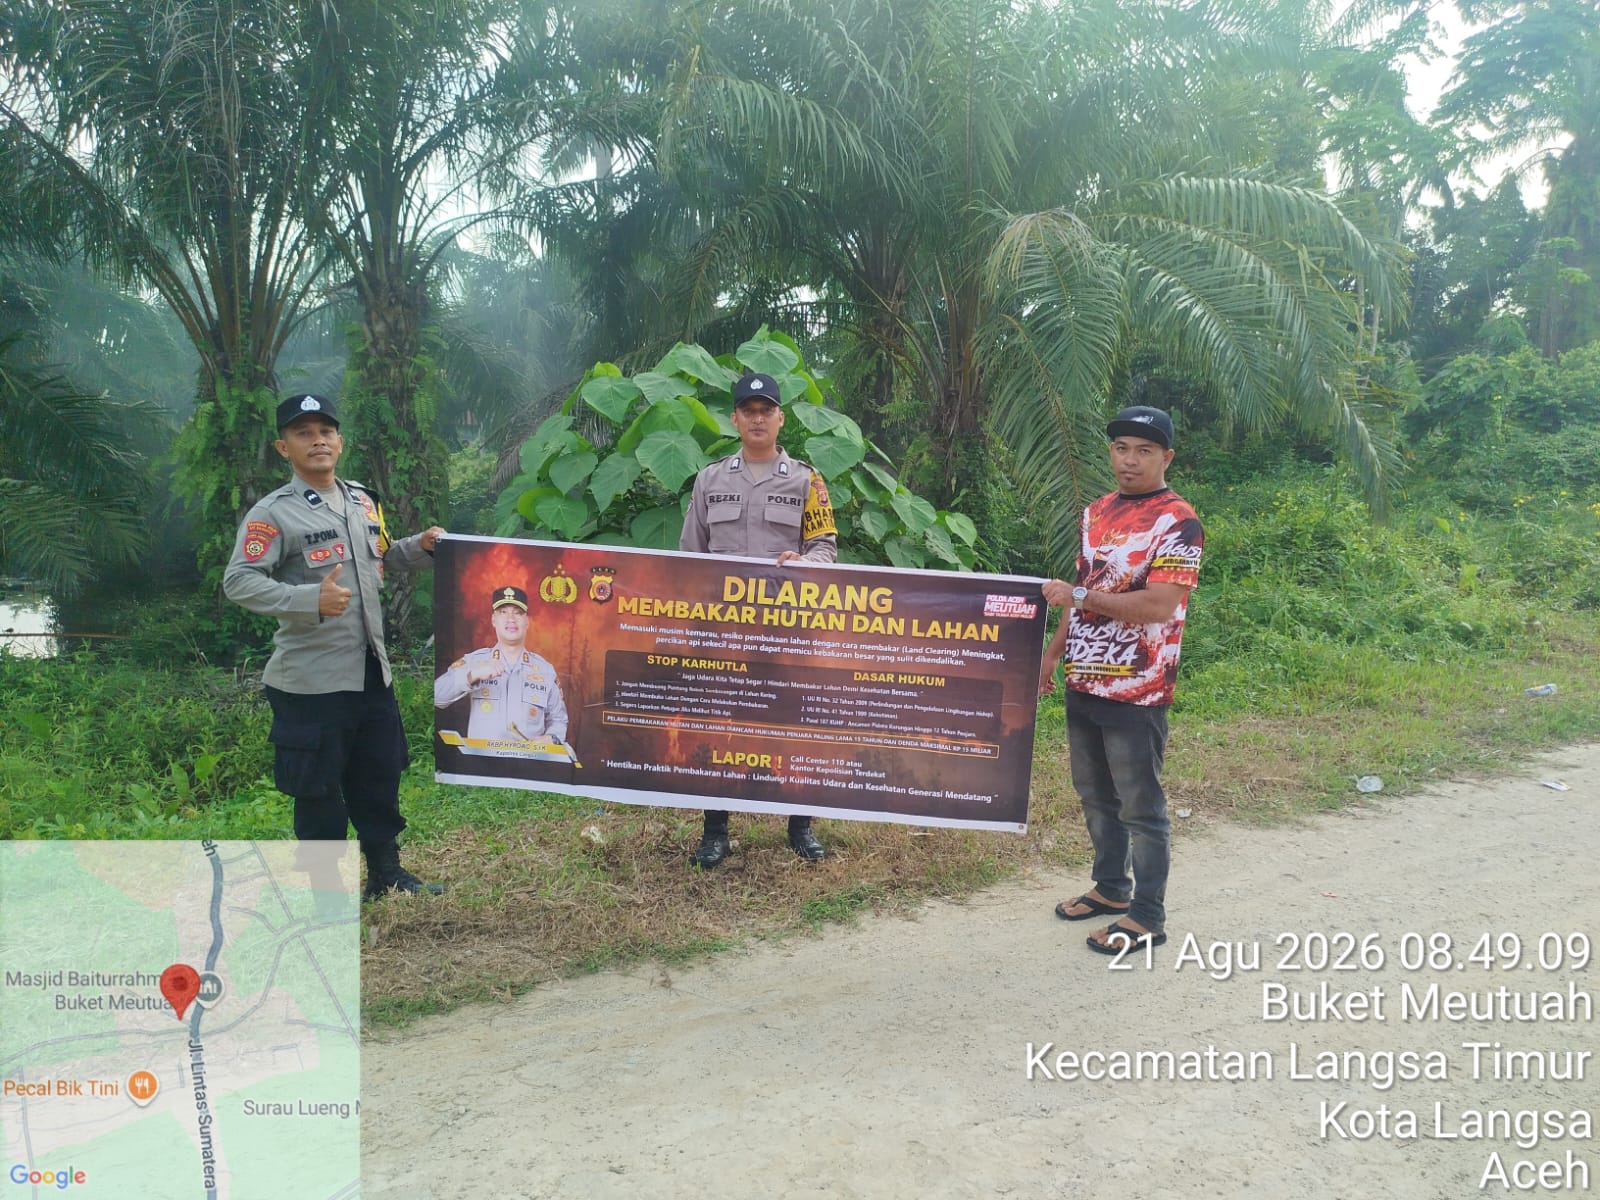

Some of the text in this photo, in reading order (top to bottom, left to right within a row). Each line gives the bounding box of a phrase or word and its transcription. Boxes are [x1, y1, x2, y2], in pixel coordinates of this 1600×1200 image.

[708, 494, 741, 504] REZKI
[767, 495, 802, 506] POLRI
[722, 574, 892, 614] DILARANG
[984, 600, 1036, 615] MEUTUAH
[617, 595, 999, 642] MEMBAKAR HUTAN DAN LAHAN
[620, 623, 656, 632] Memasuki
[658, 626, 683, 634] musim
[685, 628, 719, 638] kemarau,
[721, 631, 742, 639] resiko
[744, 633, 788, 645] pembukaan
[790, 636, 810, 645] lahan
[812, 638, 840, 649] dengan
[859, 642, 898, 652] membakar
[901, 644, 923, 654] (Land
[924, 646, 959, 658] Clearing)
[961, 649, 1005, 661] Meningkat,
[655, 635, 965, 667] percikan api sekecil apa pun dapat memicu kebakaran besar yang sulit dikendalikan.
[647, 654, 747, 672] STOP KARHUTLA
[853, 671, 945, 687] DASAR HUKUM
[790, 681, 822, 690] Membakar
[860, 686, 889, 695] Kesehatan
[712, 750, 782, 769] LAPOR !
[805, 756, 829, 764] Center
[790, 764, 885, 777] Kantor Kepolisian Terdekat
[606, 759, 991, 803] Hentikan Praktik Pembakaran Lahan Lindungi Kualitas Udara dan Kesehatan Generasi Mendatang
